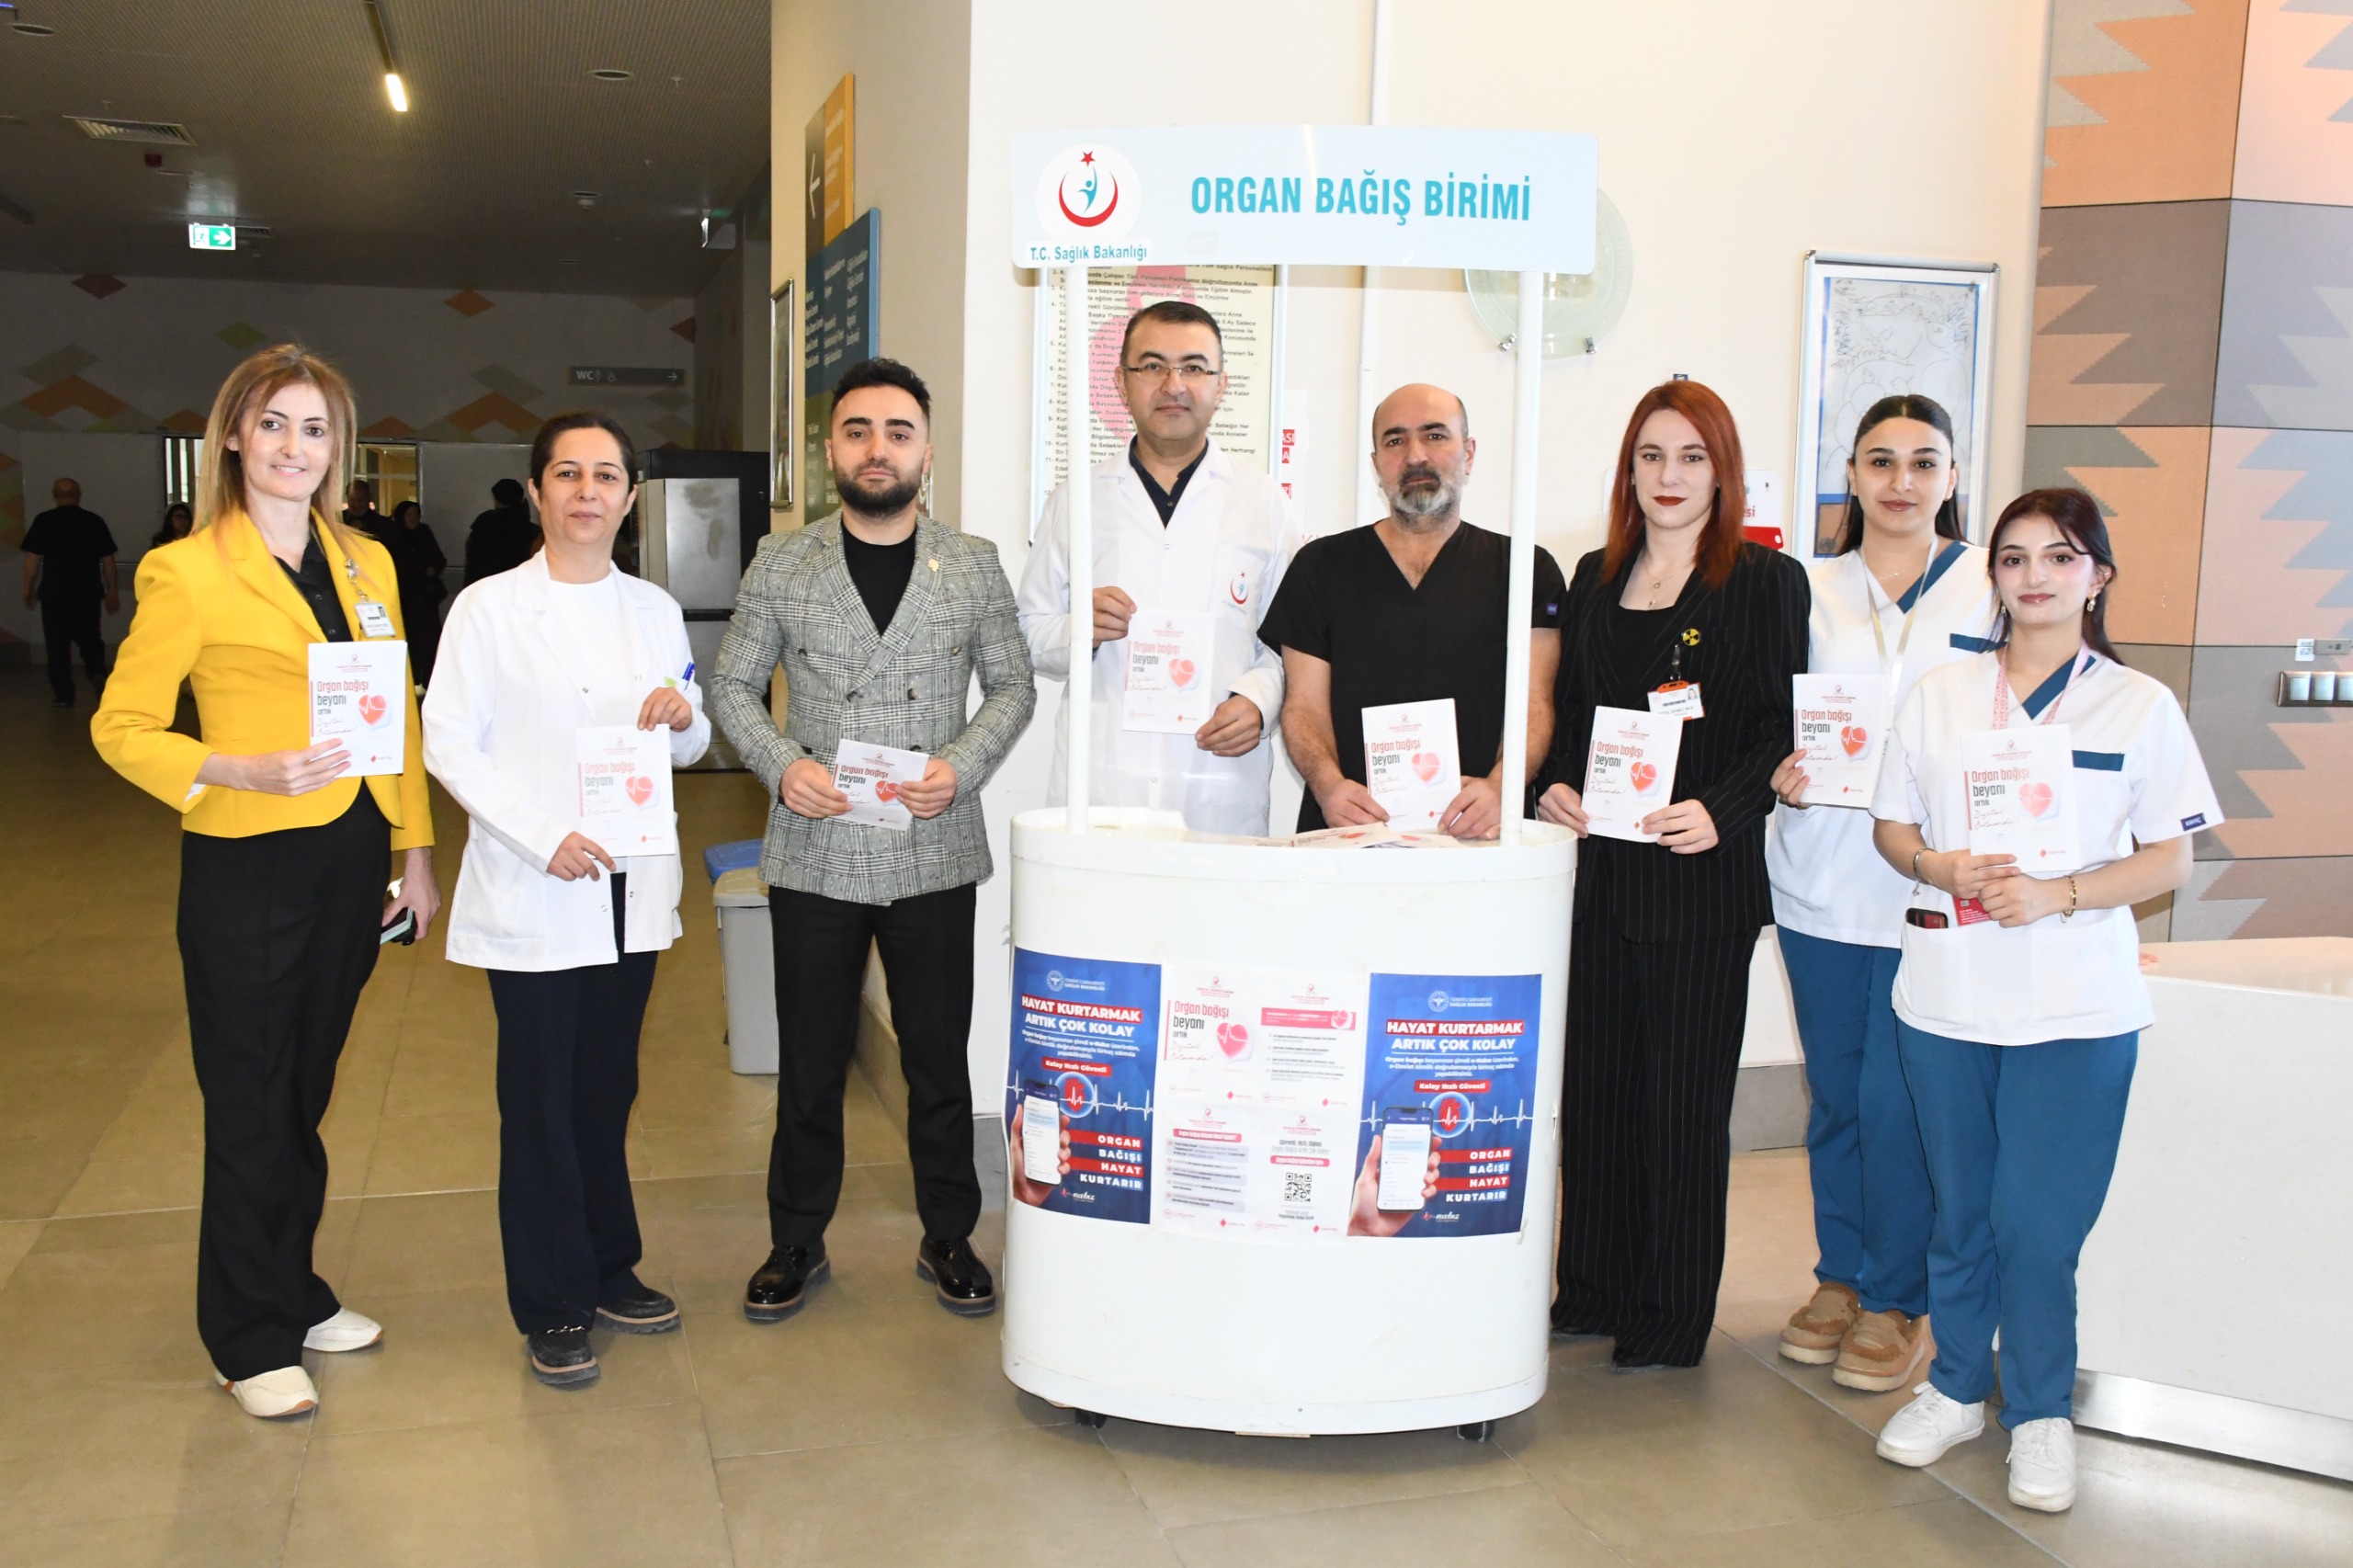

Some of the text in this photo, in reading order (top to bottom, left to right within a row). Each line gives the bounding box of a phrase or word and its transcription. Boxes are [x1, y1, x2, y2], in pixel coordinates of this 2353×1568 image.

[1191, 169, 1530, 225] ORGAN BAĞIŞ BİRİMİ
[1030, 244, 1148, 263] T.C. Sağlık Bakanlığı
[576, 370, 594, 381] WC
[1132, 653, 1159, 665] beyanı
[317, 679, 369, 693] Organ bağışı
[317, 694, 347, 706] beyanı
[1802, 710, 1852, 723] Organ bağışı
[1802, 722, 1830, 733] beyanı
[1370, 738, 1421, 754] Organ bağışı
[1597, 741, 1643, 759] Organ bağışı
[1372, 754, 1400, 767] beyanı
[1595, 754, 1621, 767] beyanı
[841, 765, 889, 778] Organ bağışı
[1972, 767, 2029, 783] Organ bağışı
[838, 773, 866, 784] beyanı
[1972, 784, 2006, 797] beyanı
[1022, 995, 1141, 1022] HAYAT KURTARMAK
[1175, 1000, 1229, 1019] Organ bağışı
[1025, 1013, 1134, 1037] ARTIK ÇOK KOLAY
[1173, 1015, 1205, 1030] beyanı
[1386, 1021, 1522, 1035] HAYAT KURTARMAK
[1392, 1039, 1516, 1052] ARTIK ÇOK KOLAY
[1046, 1060, 1063, 1069] Kolay
[1081, 1063, 1107, 1073] Güvenli
[1419, 1083, 1440, 1091] Kolay
[1097, 1135, 1141, 1147] ORGAN
[1098, 1149, 1141, 1163] BAĞIŞI
[1470, 1150, 1511, 1160] ORGAN
[1101, 1163, 1142, 1175] HAYAT
[1469, 1163, 1509, 1175] BAĞIŞI
[1080, 1174, 1142, 1189] KURTARIR
[1470, 1177, 1507, 1187] HAYAT
[1446, 1191, 1506, 1202] KURTARIR
